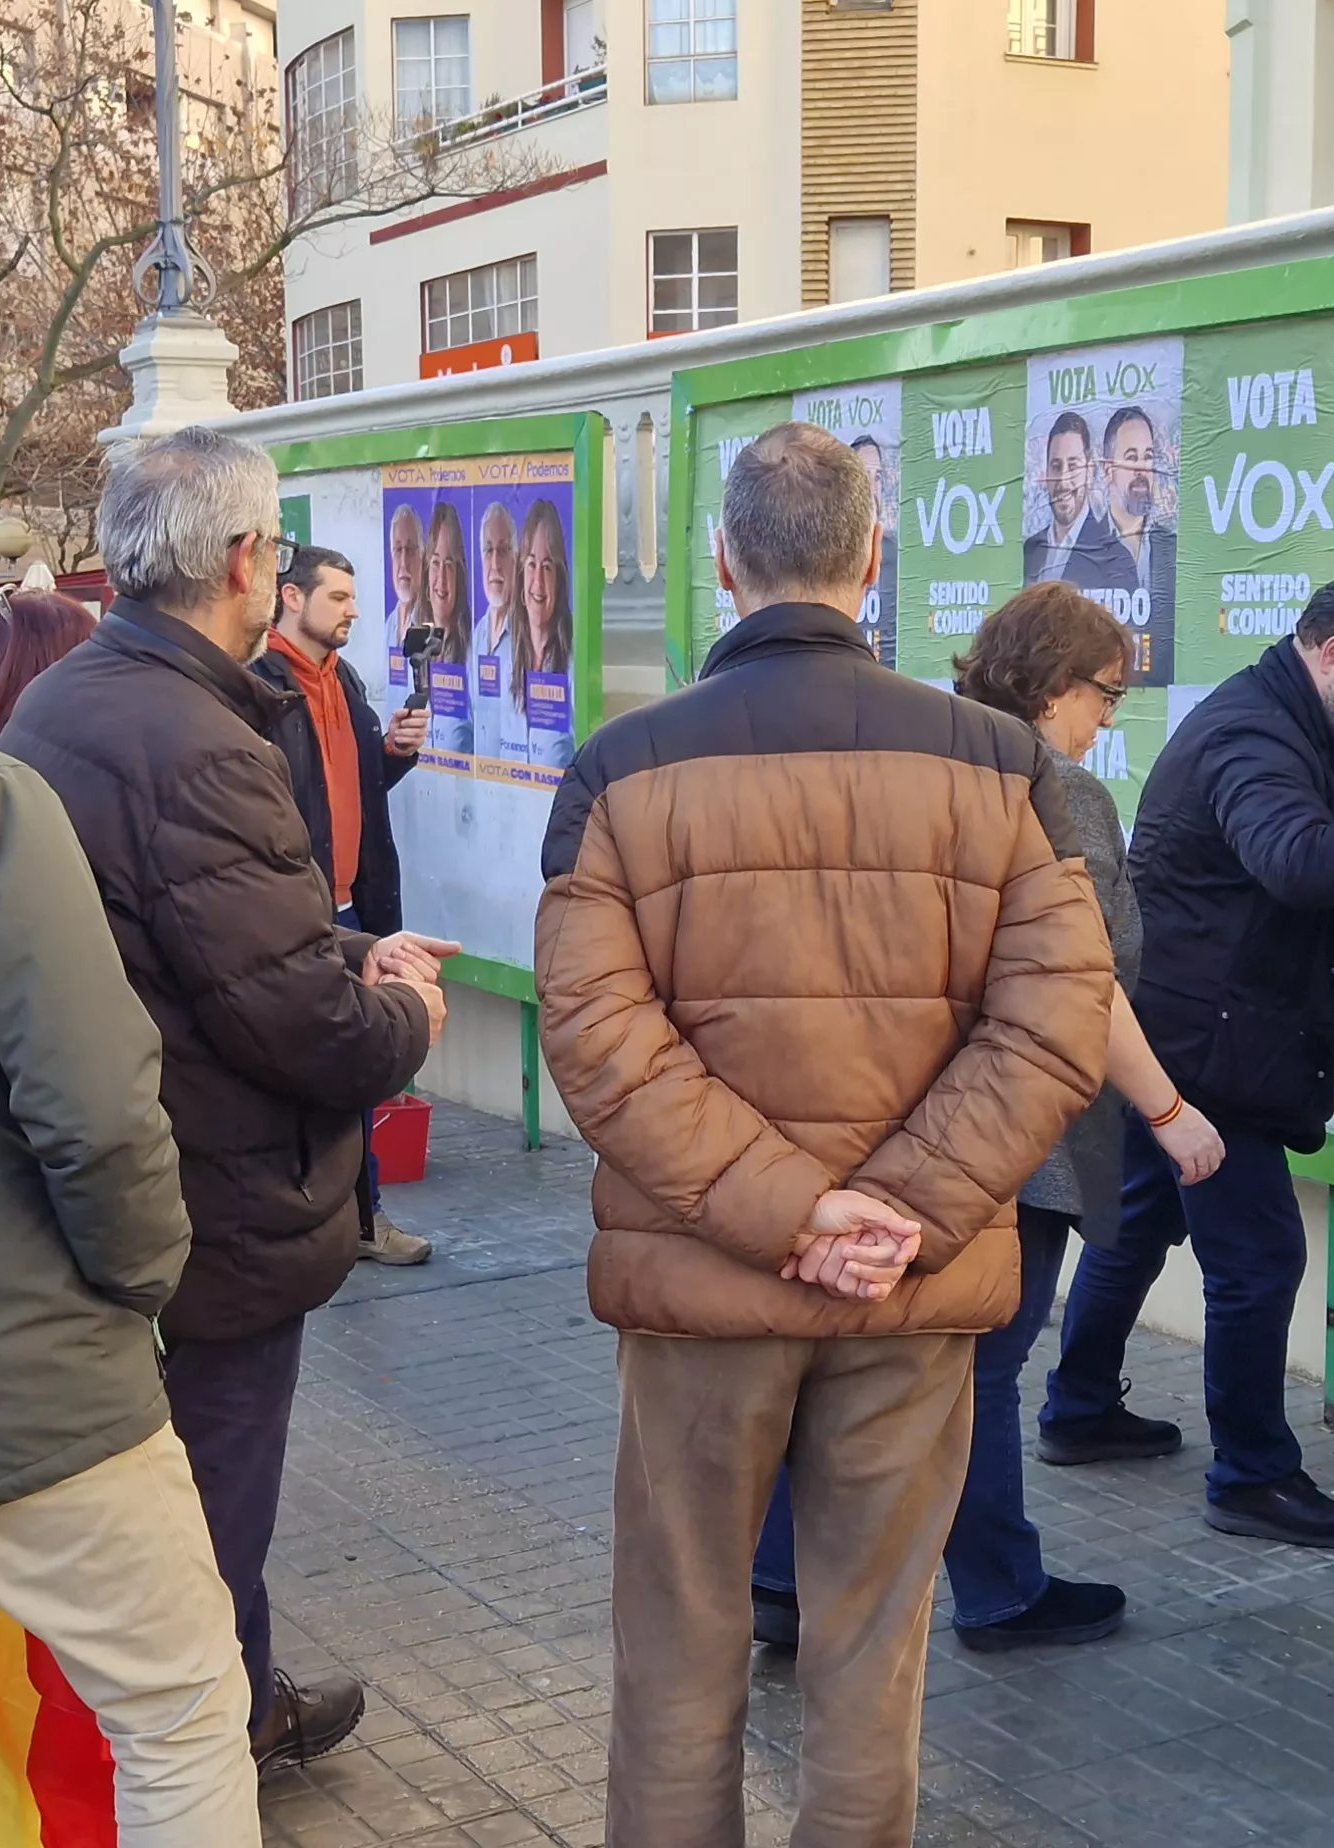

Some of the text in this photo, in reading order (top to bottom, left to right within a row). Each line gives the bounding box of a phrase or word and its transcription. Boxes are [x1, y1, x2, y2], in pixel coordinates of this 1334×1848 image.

[1048, 362, 1157, 405] VOTA VOX
[807, 395, 884, 431] VOTA VOX
[1227, 369, 1318, 431] VOTA
[931, 406, 993, 460] VOTA
[388, 468, 426, 483] VOTA
[526, 459, 569, 478] Podemos
[916, 477, 1006, 554] VOX
[929, 580, 989, 606] SENTIDO
[1221, 572, 1311, 602] SENTIDO
[933, 606, 983, 634] COMÚN
[1228, 602, 1302, 635] COMÚN
[479, 763, 510, 777] VOTA
[510, 767, 532, 781] CON
